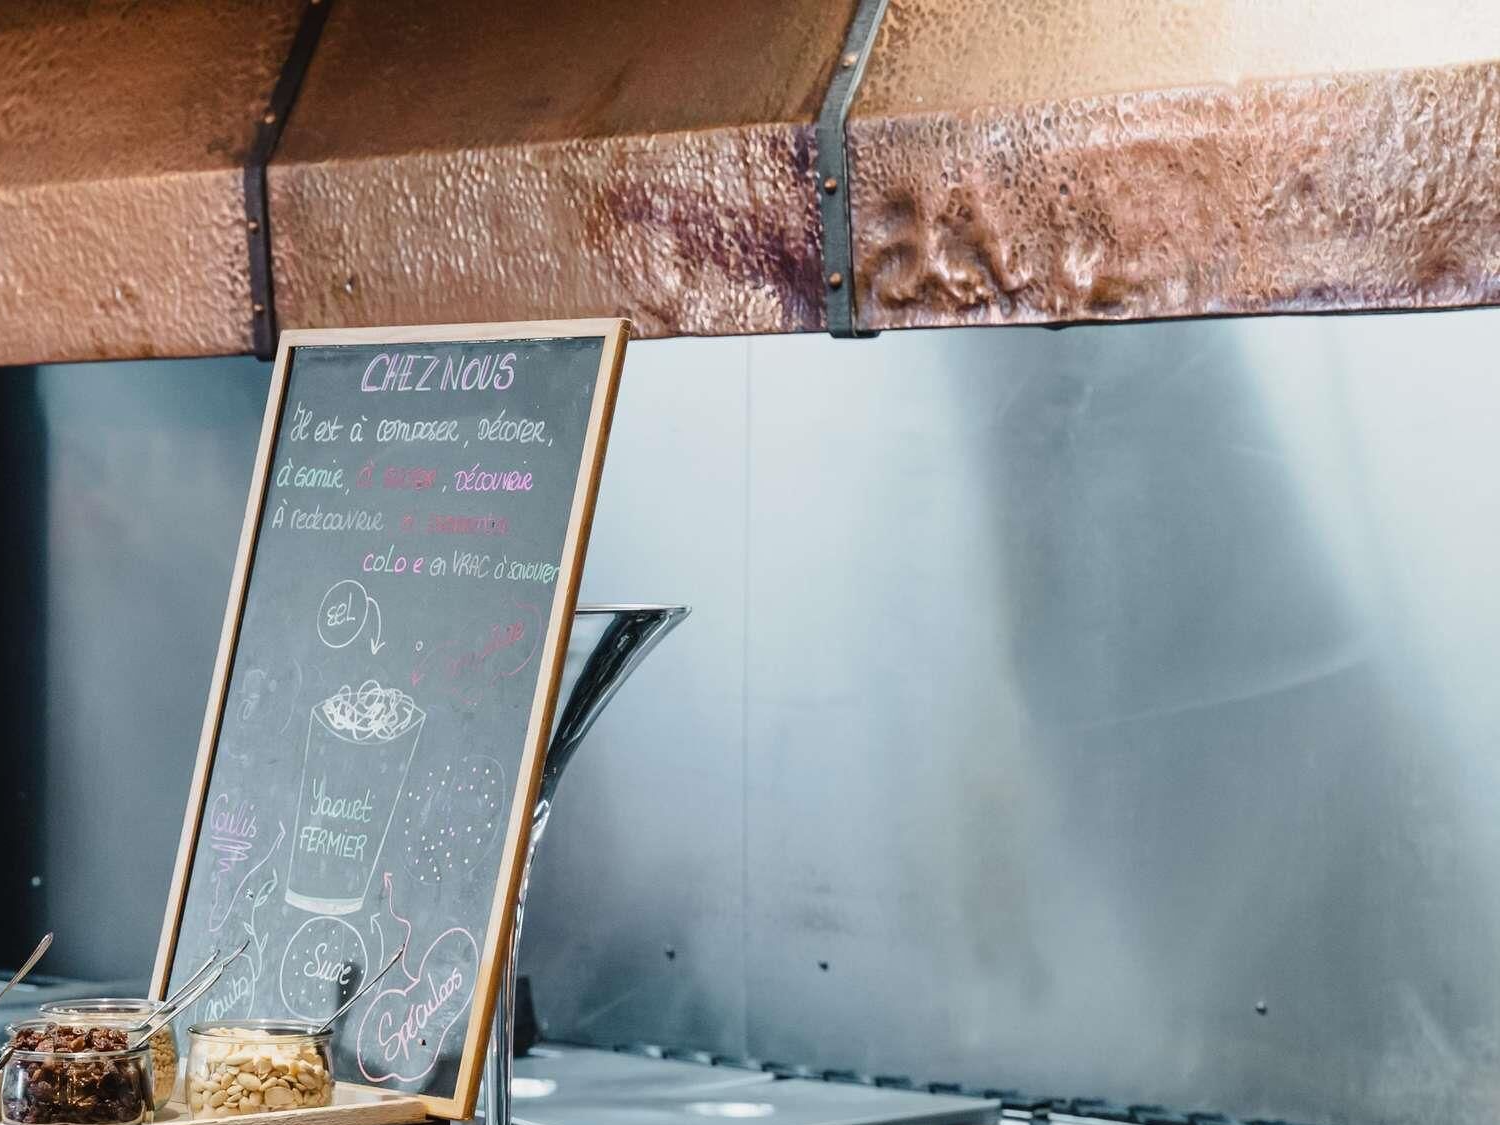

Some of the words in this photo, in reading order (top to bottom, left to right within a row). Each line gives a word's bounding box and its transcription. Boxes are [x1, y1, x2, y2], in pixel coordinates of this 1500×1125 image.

[361, 353, 440, 391] CHEZ
[440, 352, 517, 391] NOUS
[314, 415, 343, 442] est
[350, 414, 368, 442] à
[276, 458, 294, 487] à
[272, 499, 289, 529] À
[429, 556, 446, 577] en
[452, 550, 490, 578] VRAC
[494, 555, 509, 580] à
[300, 826, 368, 861] FERMIER
